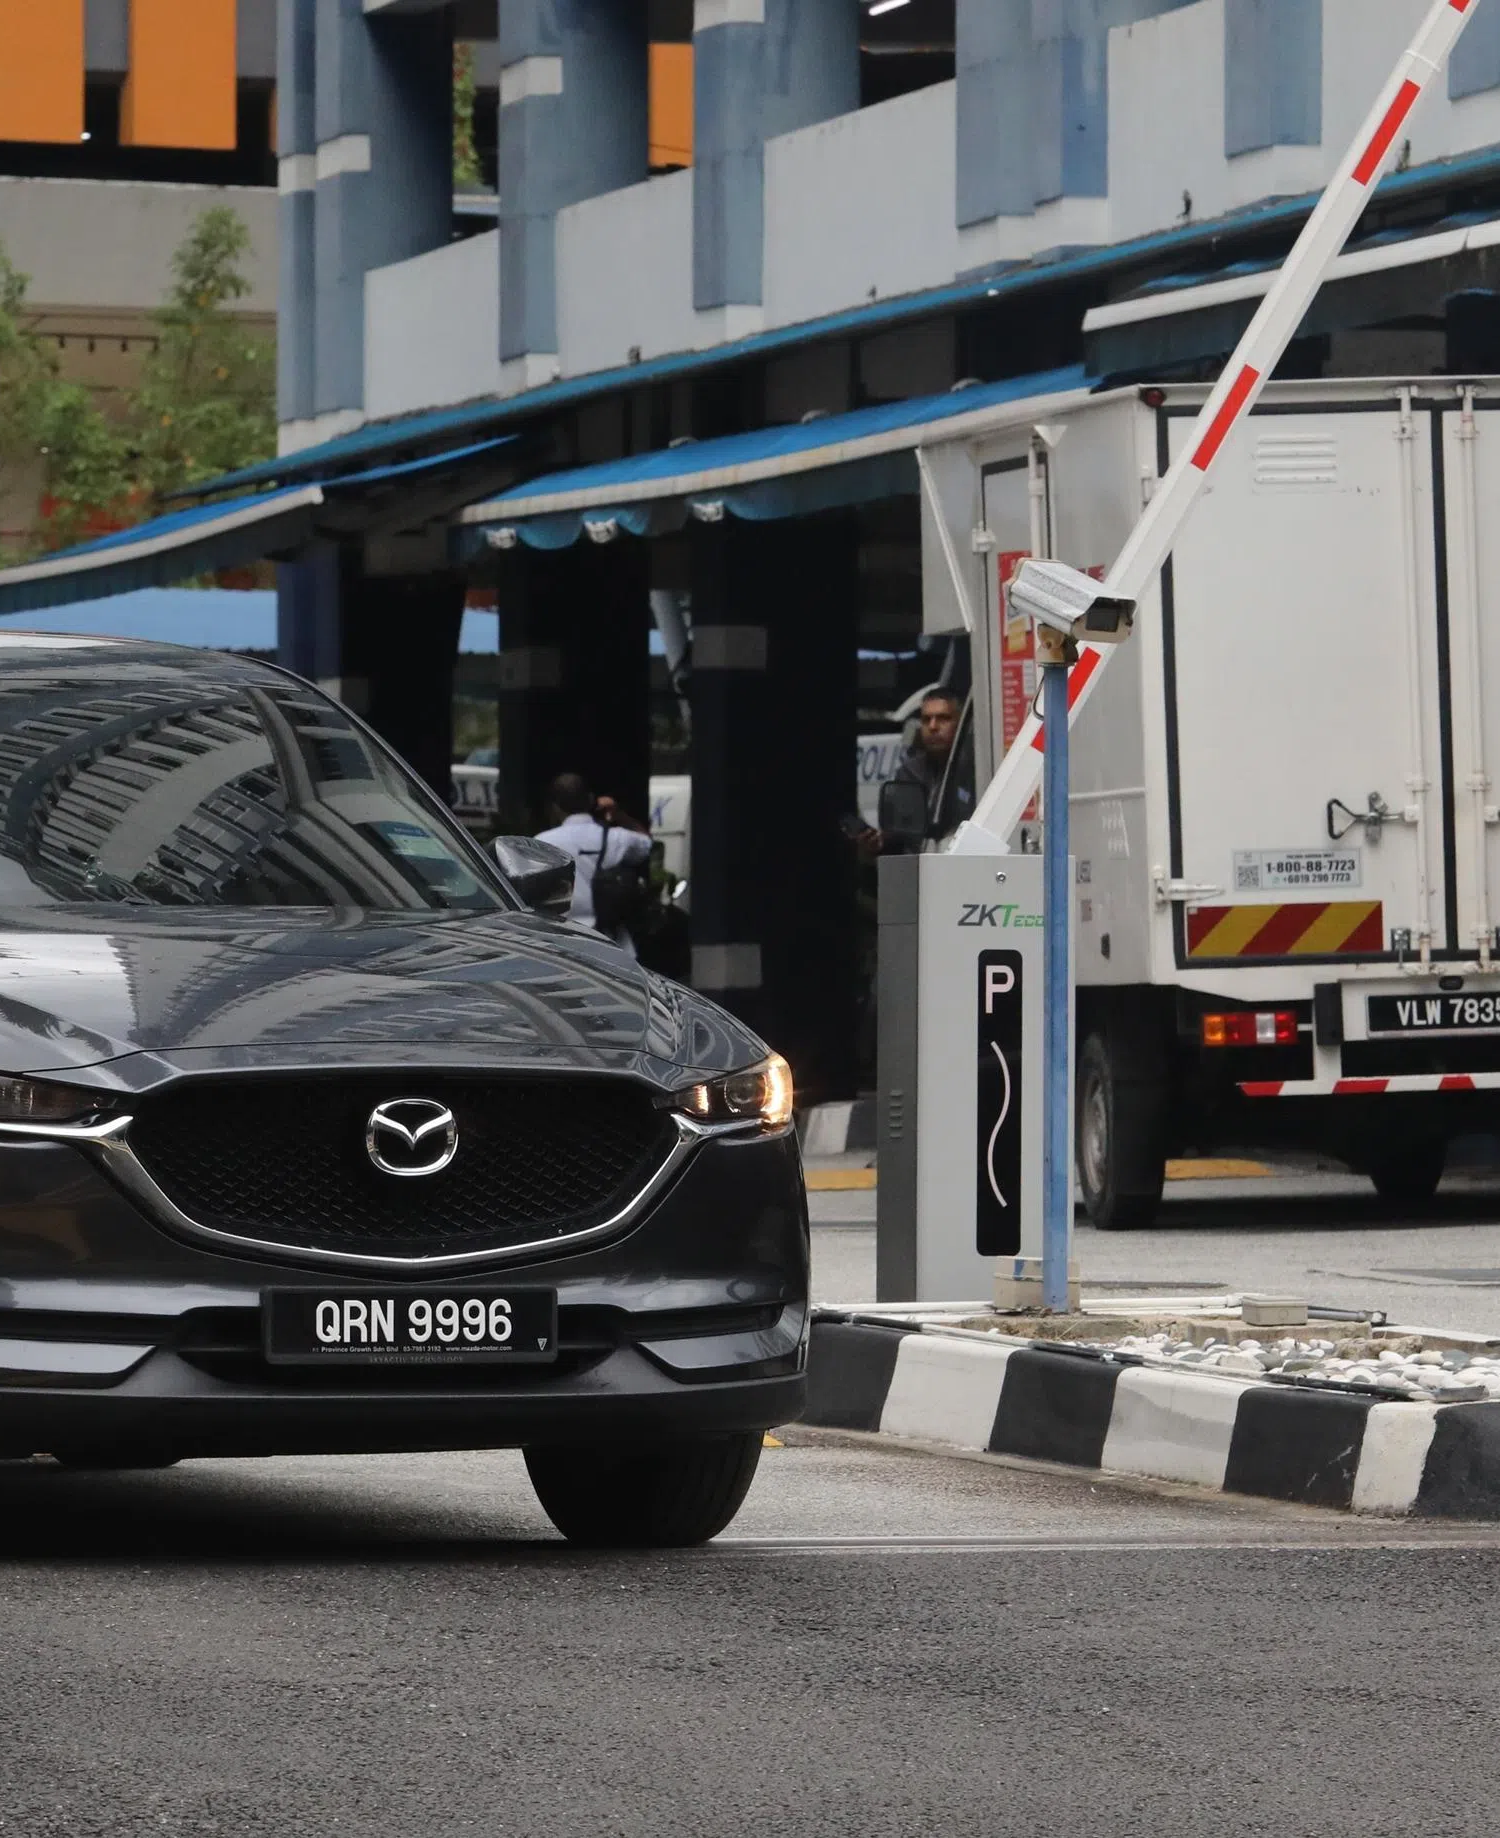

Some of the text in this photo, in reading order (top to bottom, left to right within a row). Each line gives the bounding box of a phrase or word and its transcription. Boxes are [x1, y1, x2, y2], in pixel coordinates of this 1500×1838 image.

[1266, 859, 1355, 873] 1-800-88-7723
[985, 965, 1015, 1014] P
[1396, 999, 1441, 1026] VLW
[316, 1298, 512, 1343] QRN 9996
